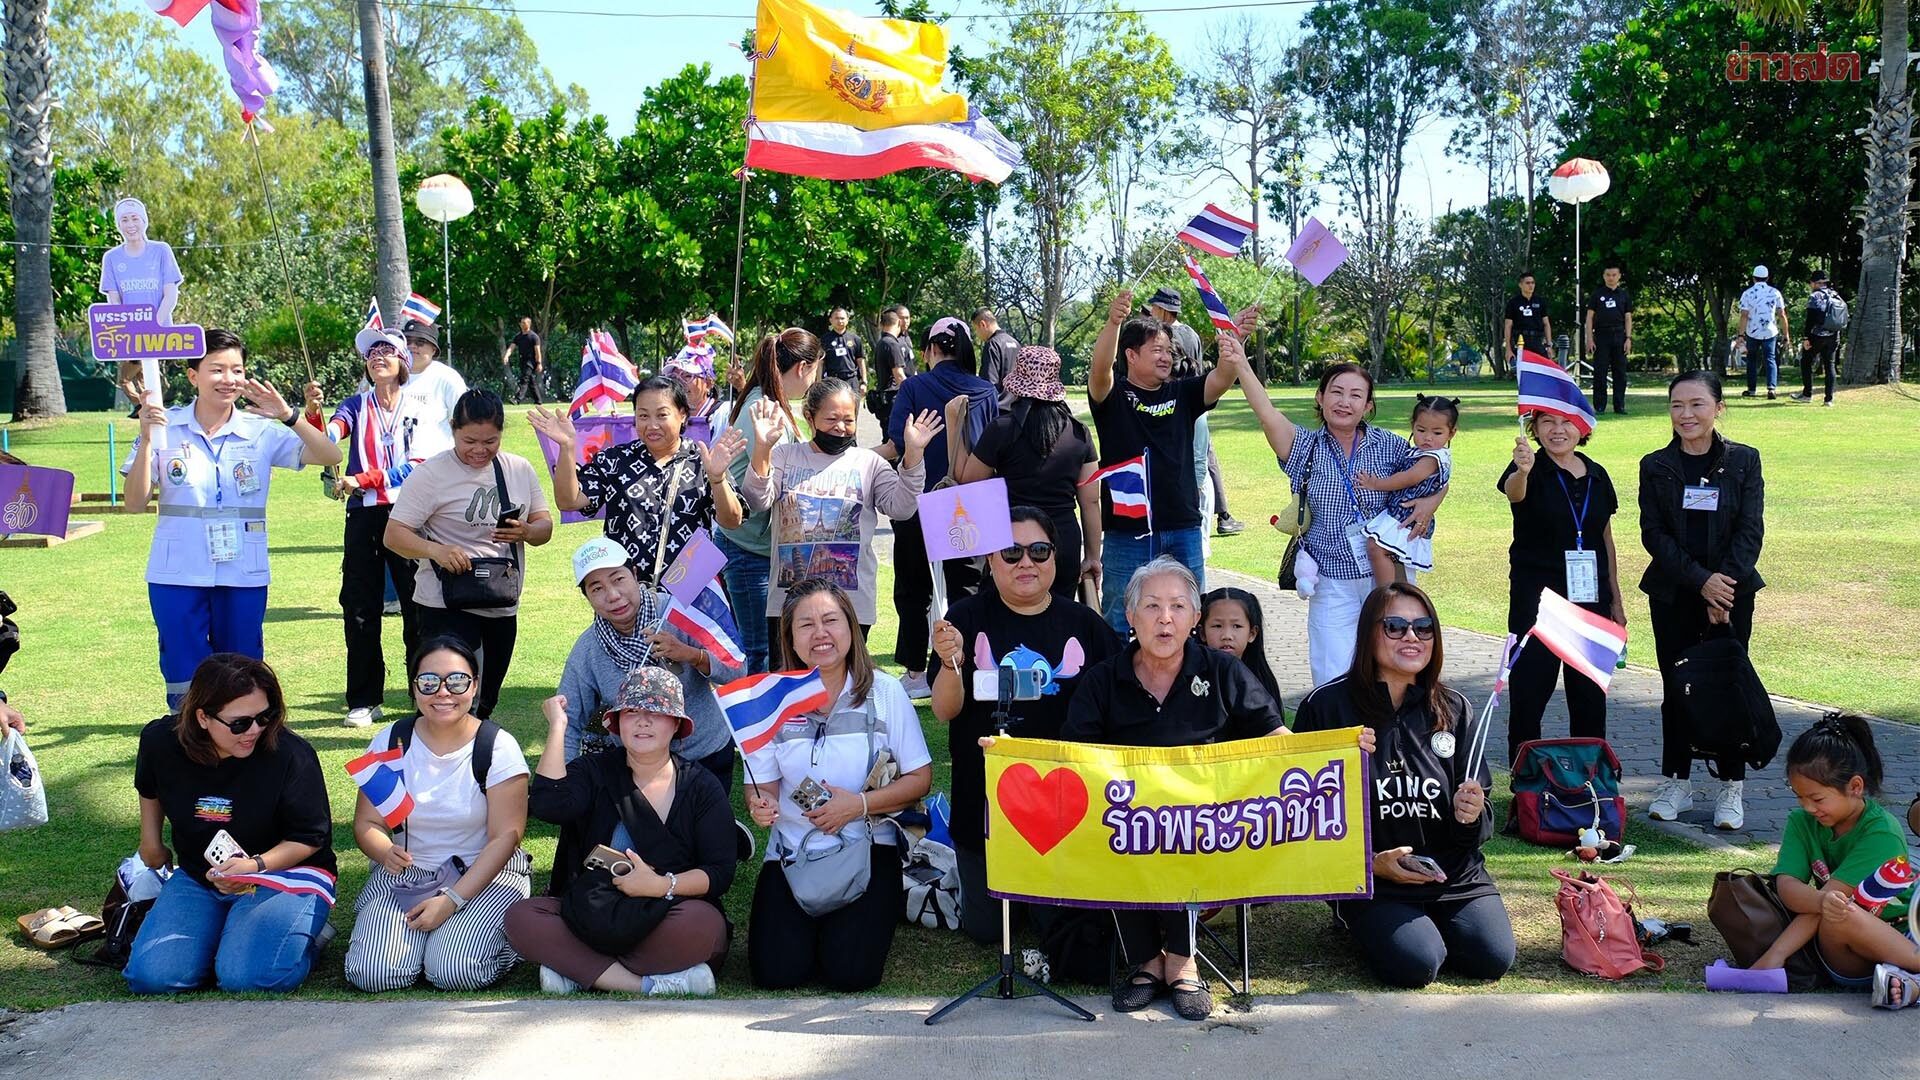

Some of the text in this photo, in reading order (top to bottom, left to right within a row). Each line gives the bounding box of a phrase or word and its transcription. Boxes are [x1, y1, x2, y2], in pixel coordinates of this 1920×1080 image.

[94, 306, 153, 323] พระราชินี
[135, 333, 195, 352] เพคะ
[1376, 776, 1441, 801] KING
[1103, 760, 1347, 855] รักพระราชินี
